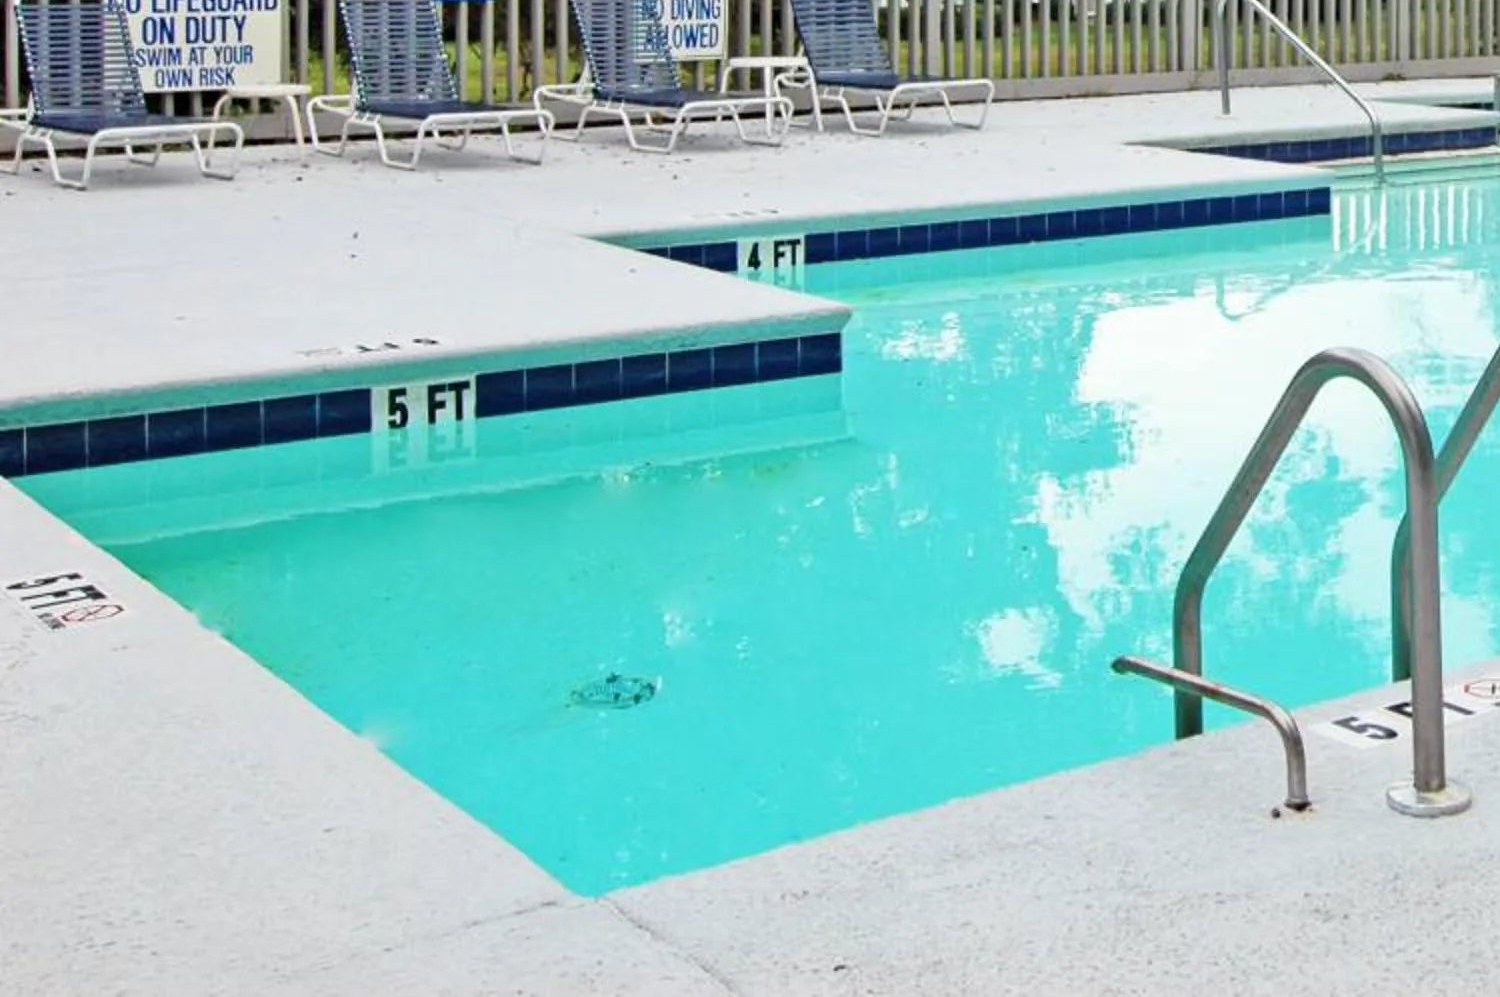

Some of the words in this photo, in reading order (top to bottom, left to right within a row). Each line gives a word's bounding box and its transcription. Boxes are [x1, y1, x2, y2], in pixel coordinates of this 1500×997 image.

[142, 16, 175, 46] ON
[186, 15, 247, 45] DUTY
[135, 47, 182, 68] SWIM
[188, 47, 206, 66] AT
[215, 45, 253, 65] YOUR
[156, 69, 192, 89] OWN
[199, 67, 236, 87] RISK
[747, 242, 761, 270] 4
[773, 239, 801, 268] FT
[388, 388, 409, 429] 5
[427, 380, 471, 425] FT
[1331, 716, 1398, 740] 5
